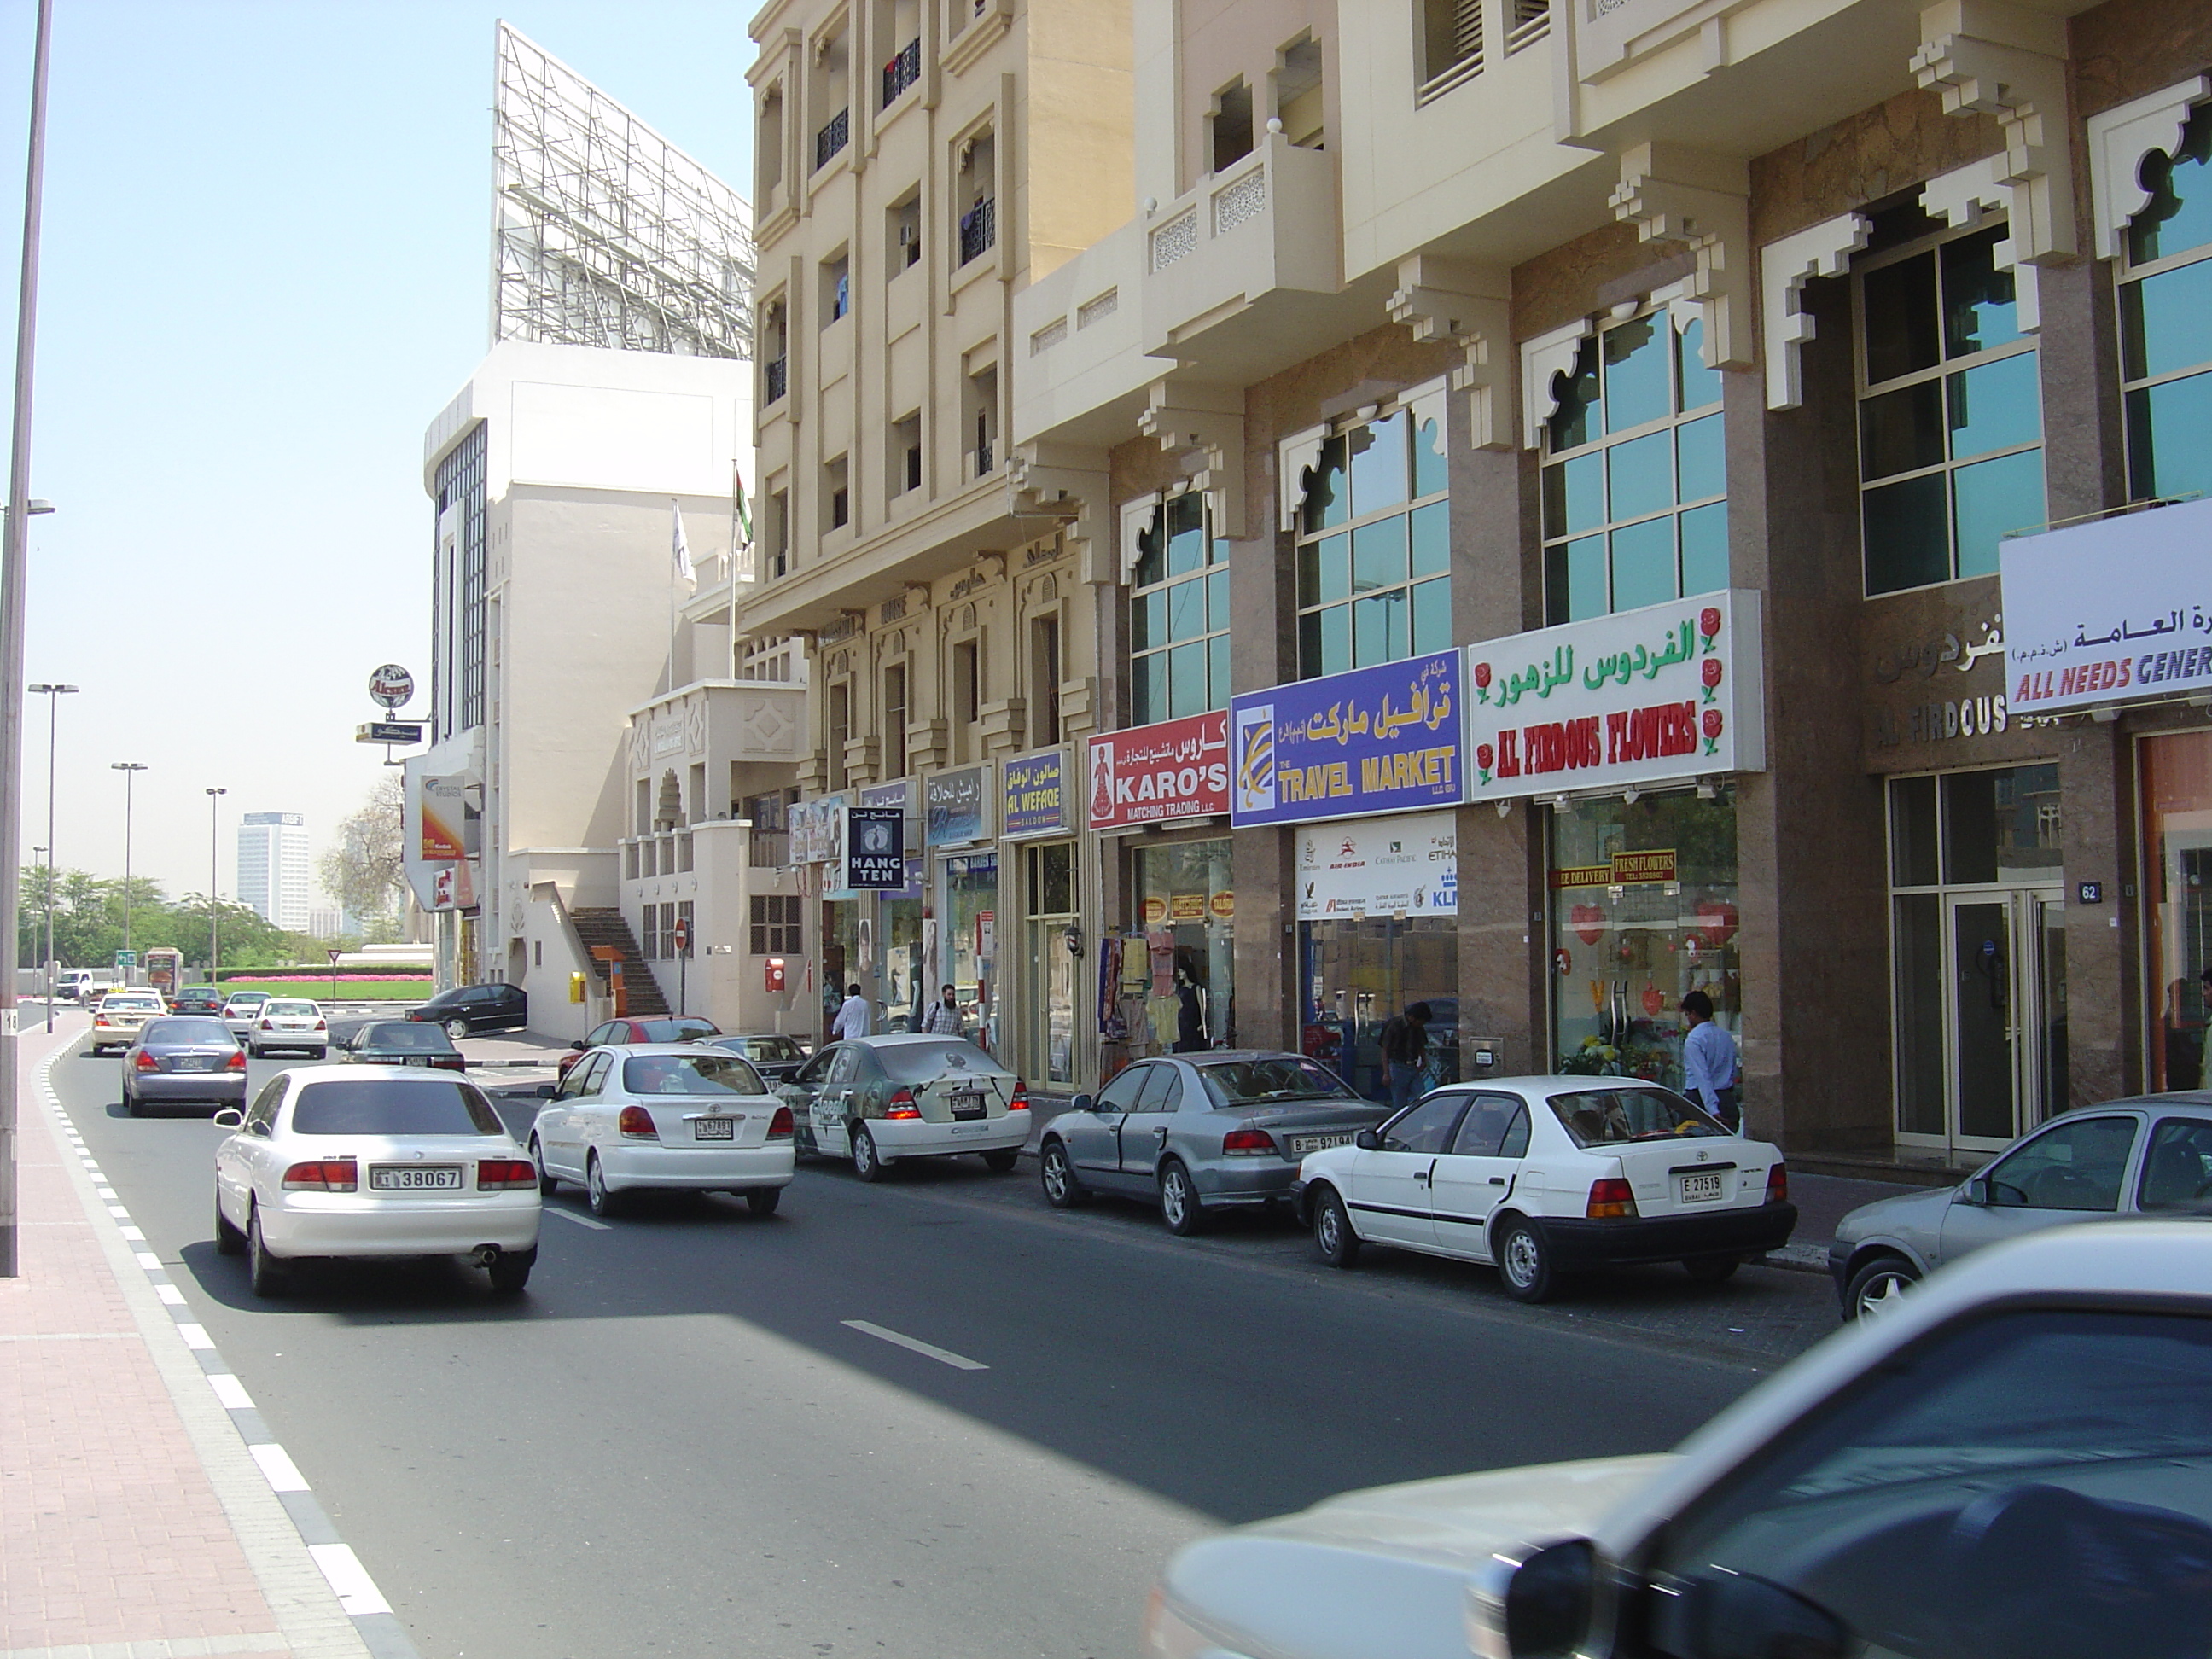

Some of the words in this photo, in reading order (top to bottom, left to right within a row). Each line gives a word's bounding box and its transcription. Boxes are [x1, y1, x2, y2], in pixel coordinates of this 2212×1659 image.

[2074, 608, 2184, 648] العامة
[1583, 619, 1694, 690] الفردوس
[1877, 613, 2005, 684] فردوس
[1429, 660, 1447, 680] شركة
[1493, 644, 1574, 707] للزهور
[2014, 670, 2054, 703] ALL
[2058, 657, 2132, 696] NEEDS
[2137, 646, 2212, 684] GENER
[1374, 681, 1451, 739] ترافيل
[1910, 694, 2006, 742] FIRDOUS
[1307, 699, 1369, 746] ماركت
[1175, 718, 1227, 763] كاروس
[1497, 729, 1520, 778] AL
[1524, 716, 1601, 775] FIRDOUS
[1607, 700, 1697, 764] FLOWERS
[1033, 763, 1059, 786] صالون
[1278, 761, 1353, 803] TRAVEL
[1361, 745, 1455, 794] MARKET
[1279, 760, 1290, 769] THE
[1007, 766, 1031, 790] الوفاق
[1116, 763, 1227, 804] KARO'S
[1007, 795, 1019, 815] AL
[1127, 806, 1164, 820] MATCHING
[1165, 800, 1200, 816] TRADING
[870, 811, 900, 820] هانج
[1021, 816, 1045, 826] SALOON
[851, 857, 901, 869] HANG
[1428, 849, 1457, 861] ETIHA
[1615, 857, 1638, 872] FRESH
[1639, 855, 1674, 870] FLOWERS
[860, 870, 893, 881] TEN
[1571, 870, 1610, 883] DELIVERY
[2082, 886, 2096, 899] 62
[707, 1121, 731, 1130] 67891
[1295, 1140, 1301, 1150] B
[403, 1172, 457, 1187] 38067
[1685, 1179, 1690, 1191] E
[1694, 1176, 1720, 1191] 27519
